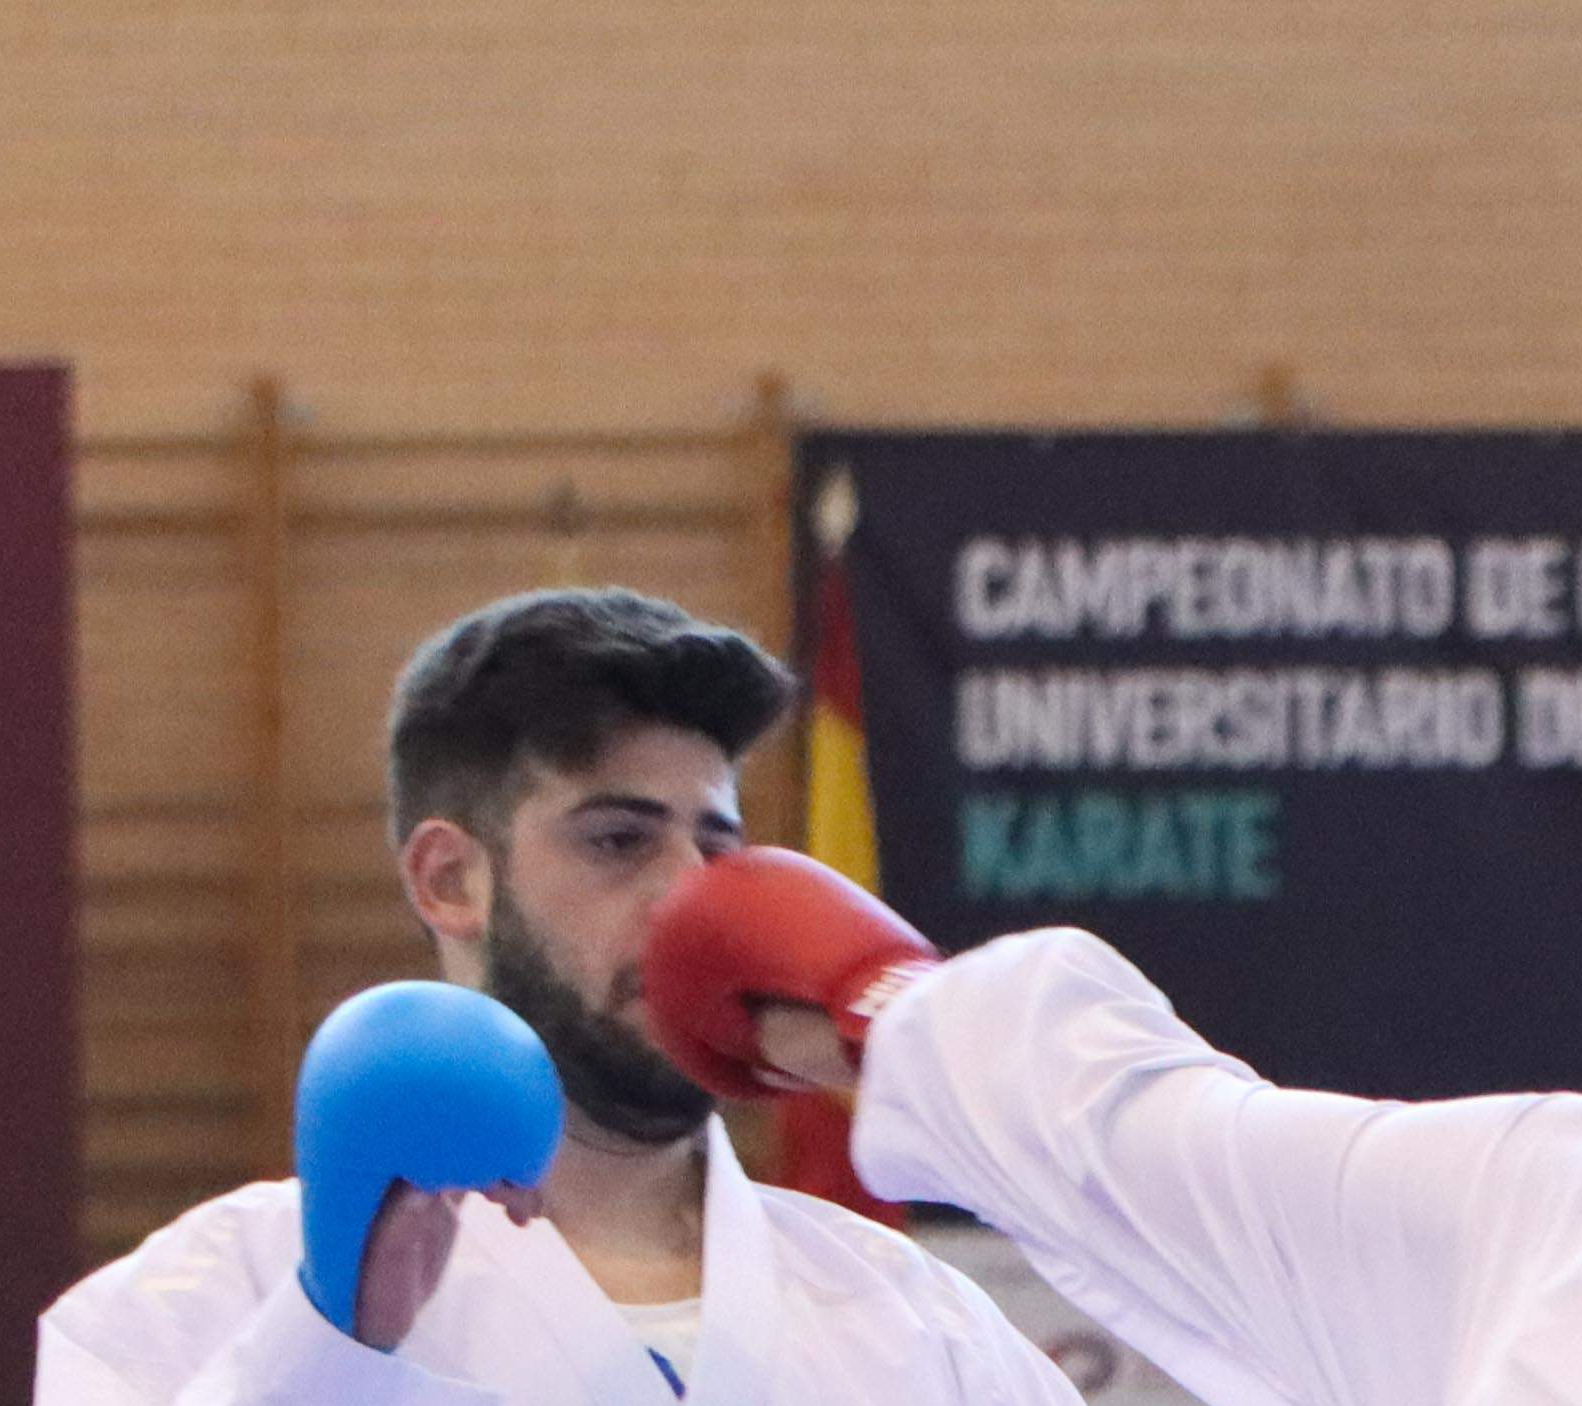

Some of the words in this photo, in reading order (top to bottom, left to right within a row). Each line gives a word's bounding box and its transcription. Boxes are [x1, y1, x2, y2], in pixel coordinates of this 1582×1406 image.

[956, 536, 1456, 640] CAMPEONATO
[1464, 536, 1571, 640] DE
[956, 665, 1505, 770] UNIVERSITARIO
[961, 791, 1281, 901] KARATE
